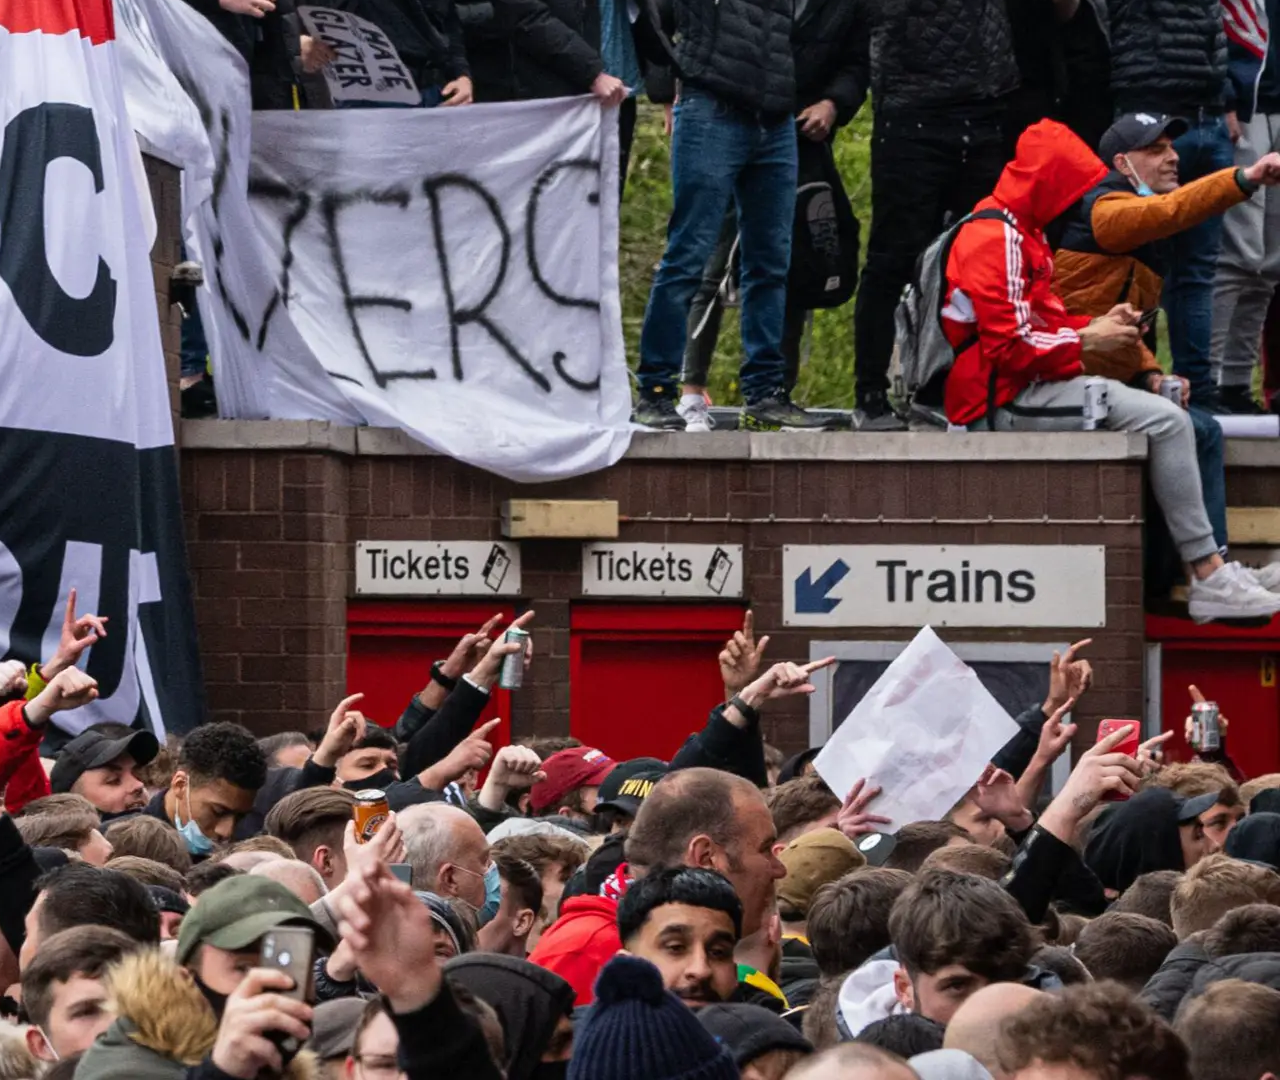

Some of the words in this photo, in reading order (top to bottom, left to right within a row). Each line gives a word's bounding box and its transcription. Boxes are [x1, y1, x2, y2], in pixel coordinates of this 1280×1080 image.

[308, 10, 373, 89] GLAZER
[357, 27, 414, 91] HATE
[366, 548, 470, 581] Tickets
[592, 550, 693, 582] Tickets
[876, 559, 1036, 603] Trains
